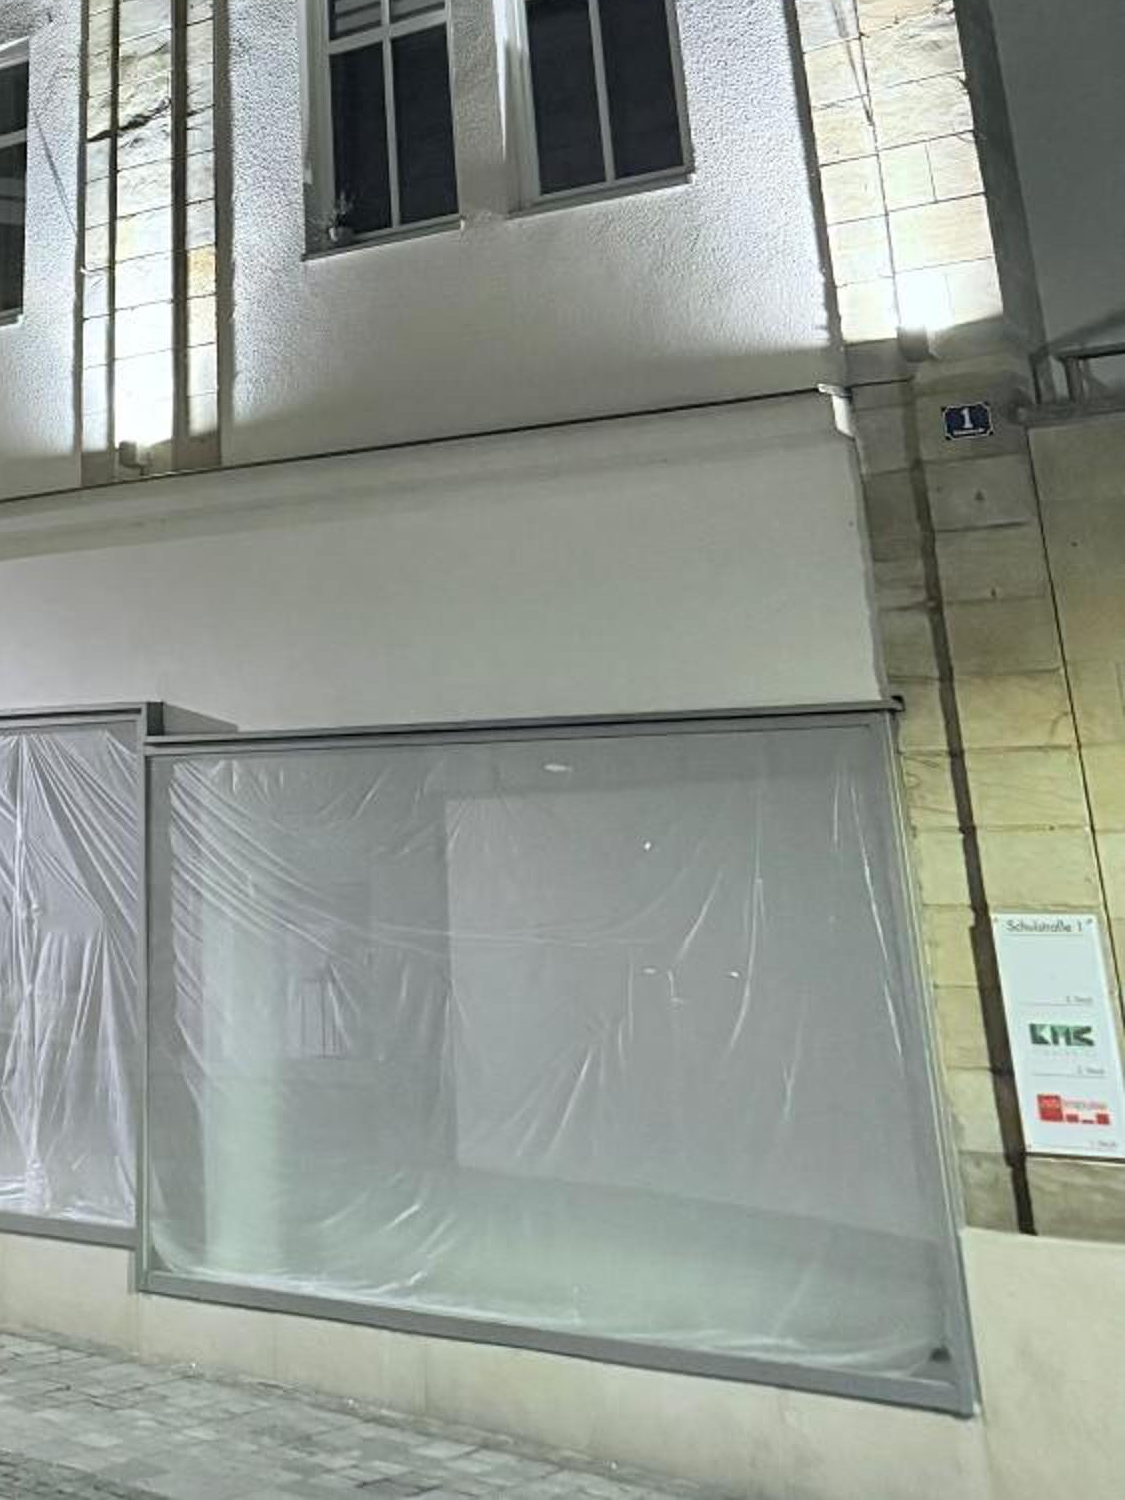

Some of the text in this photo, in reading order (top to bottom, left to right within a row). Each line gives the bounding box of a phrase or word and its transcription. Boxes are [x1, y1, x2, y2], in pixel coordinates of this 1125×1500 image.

[961, 407, 973, 428] 1
[1006, 918, 1083, 932] Schulstraße 1
